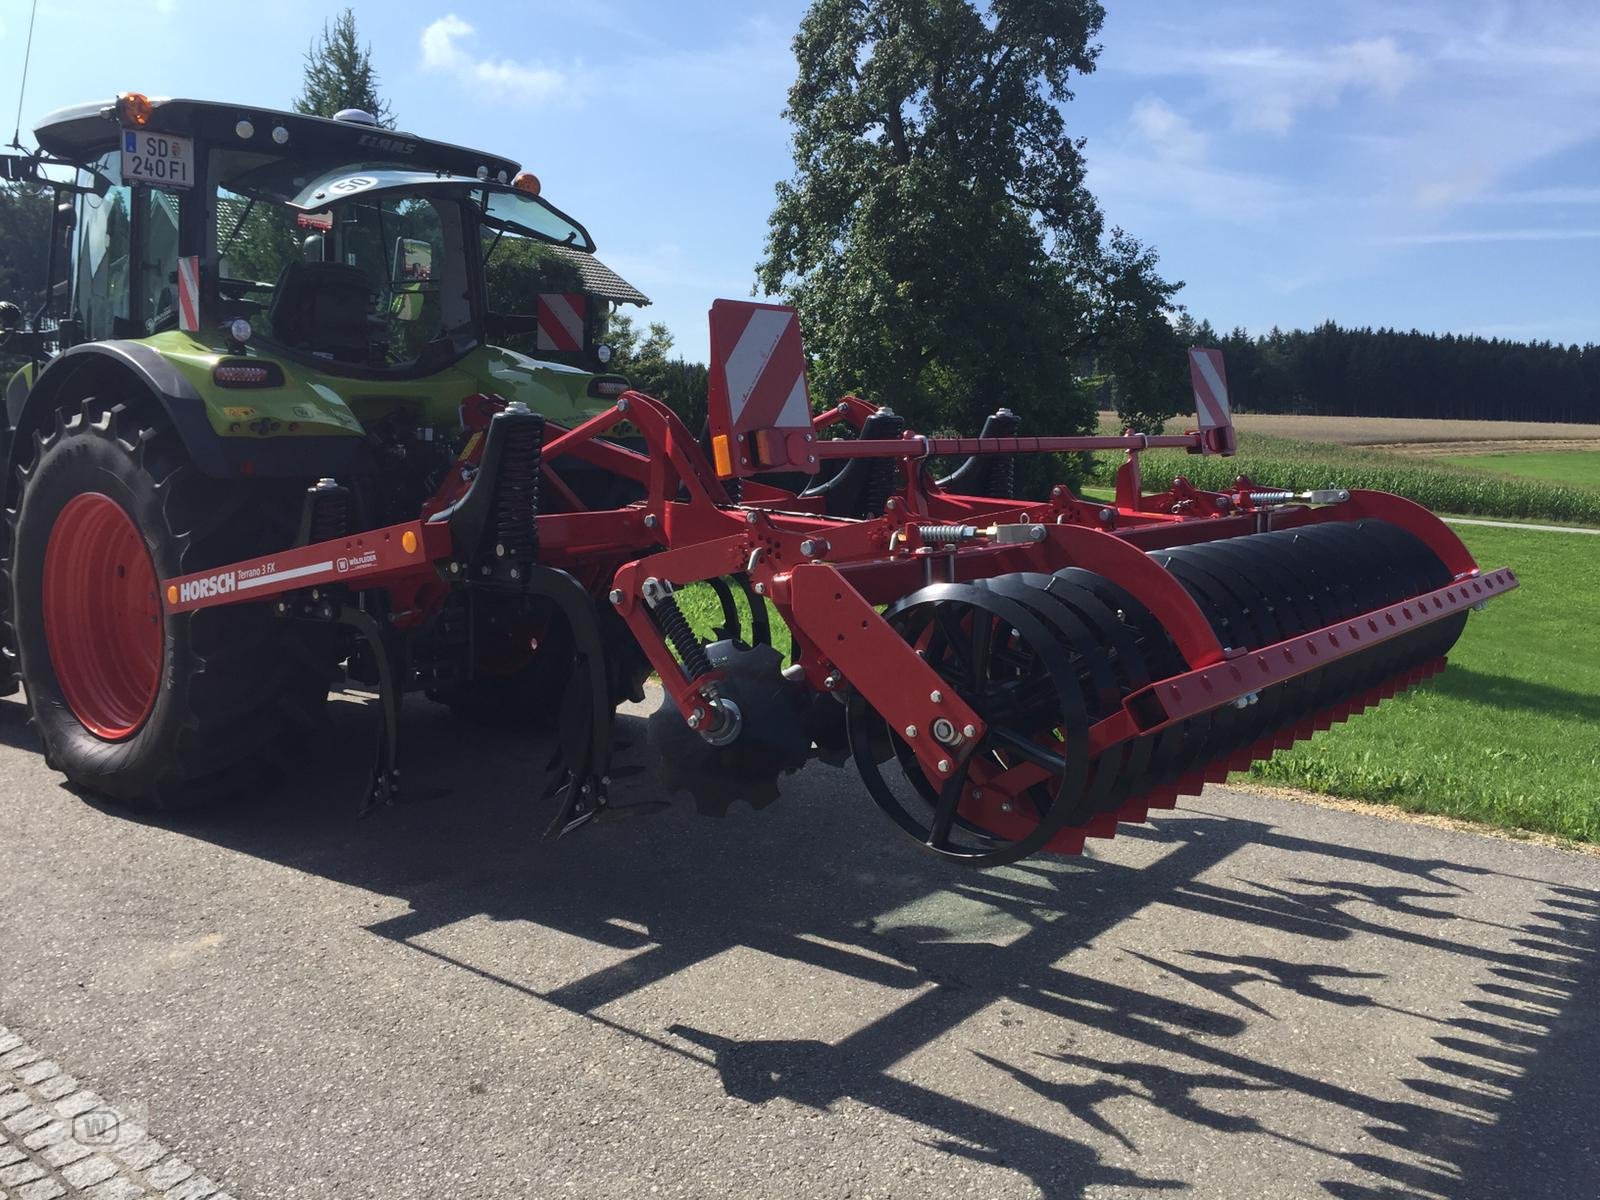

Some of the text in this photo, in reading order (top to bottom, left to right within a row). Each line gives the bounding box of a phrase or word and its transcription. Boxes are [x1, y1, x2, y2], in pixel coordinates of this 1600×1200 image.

[146, 137, 168, 158] SD
[334, 178, 371, 192] 50
[237, 562, 276, 580] Terrano 3 FX
[180, 571, 236, 603] HORSCH
